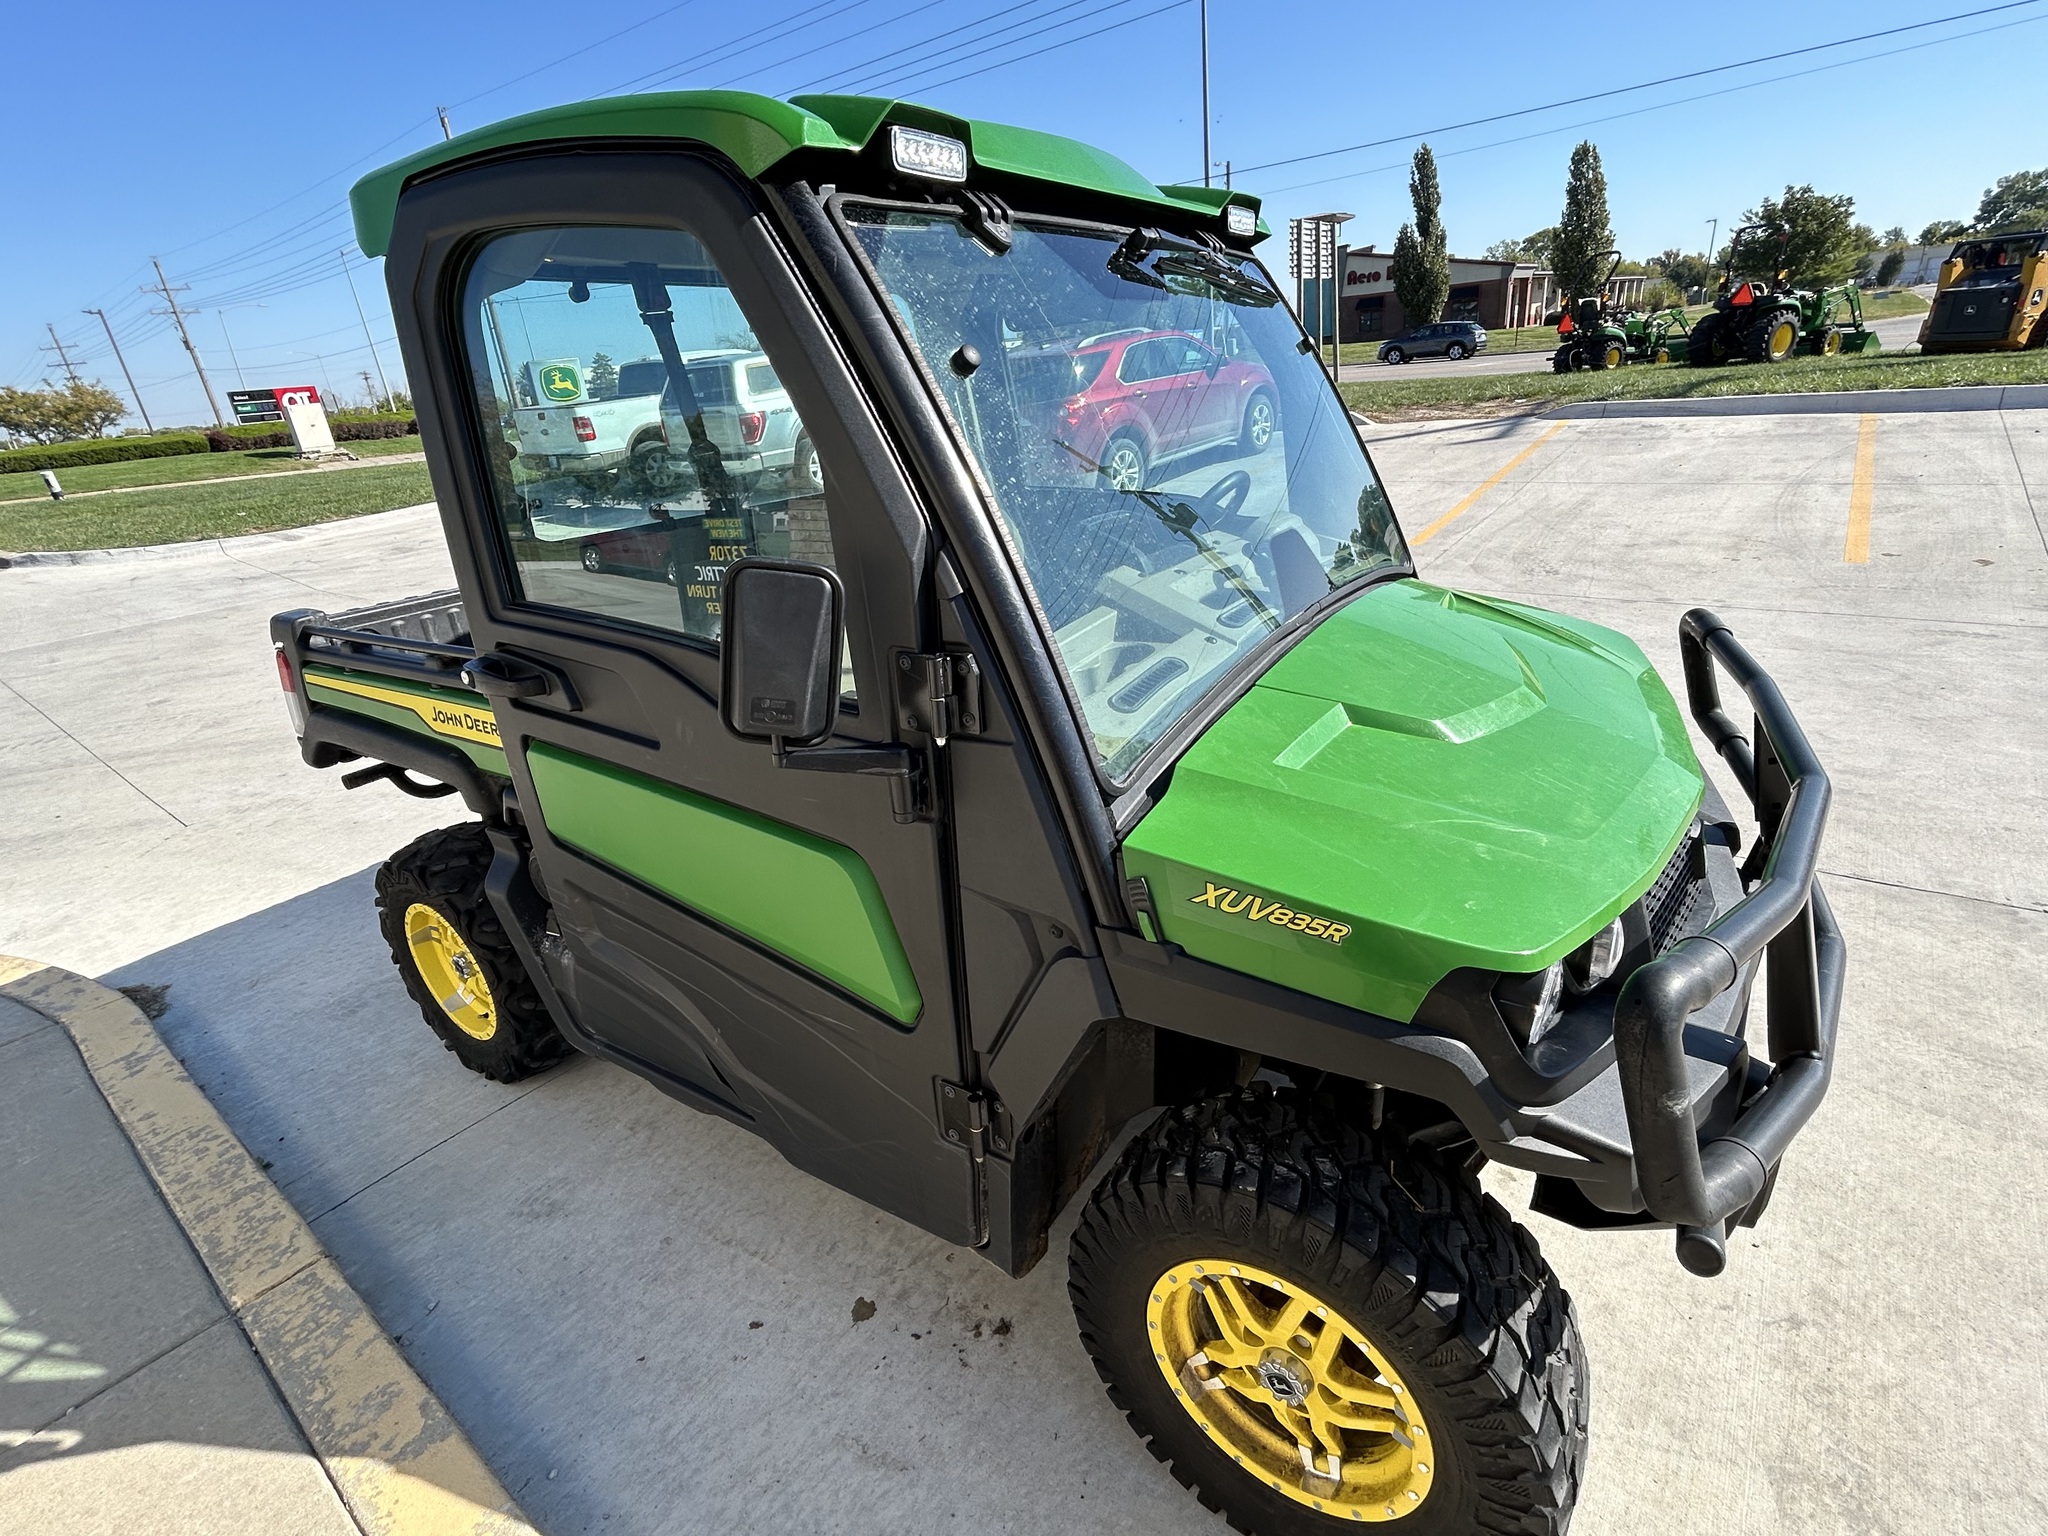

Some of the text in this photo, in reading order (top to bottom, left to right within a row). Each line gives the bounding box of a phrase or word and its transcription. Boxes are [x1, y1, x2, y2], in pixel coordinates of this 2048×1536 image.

[1347, 270, 1381, 285] Aero
[432, 706, 500, 736] JOHN DEER
[1187, 881, 1351, 944] XUV835R
